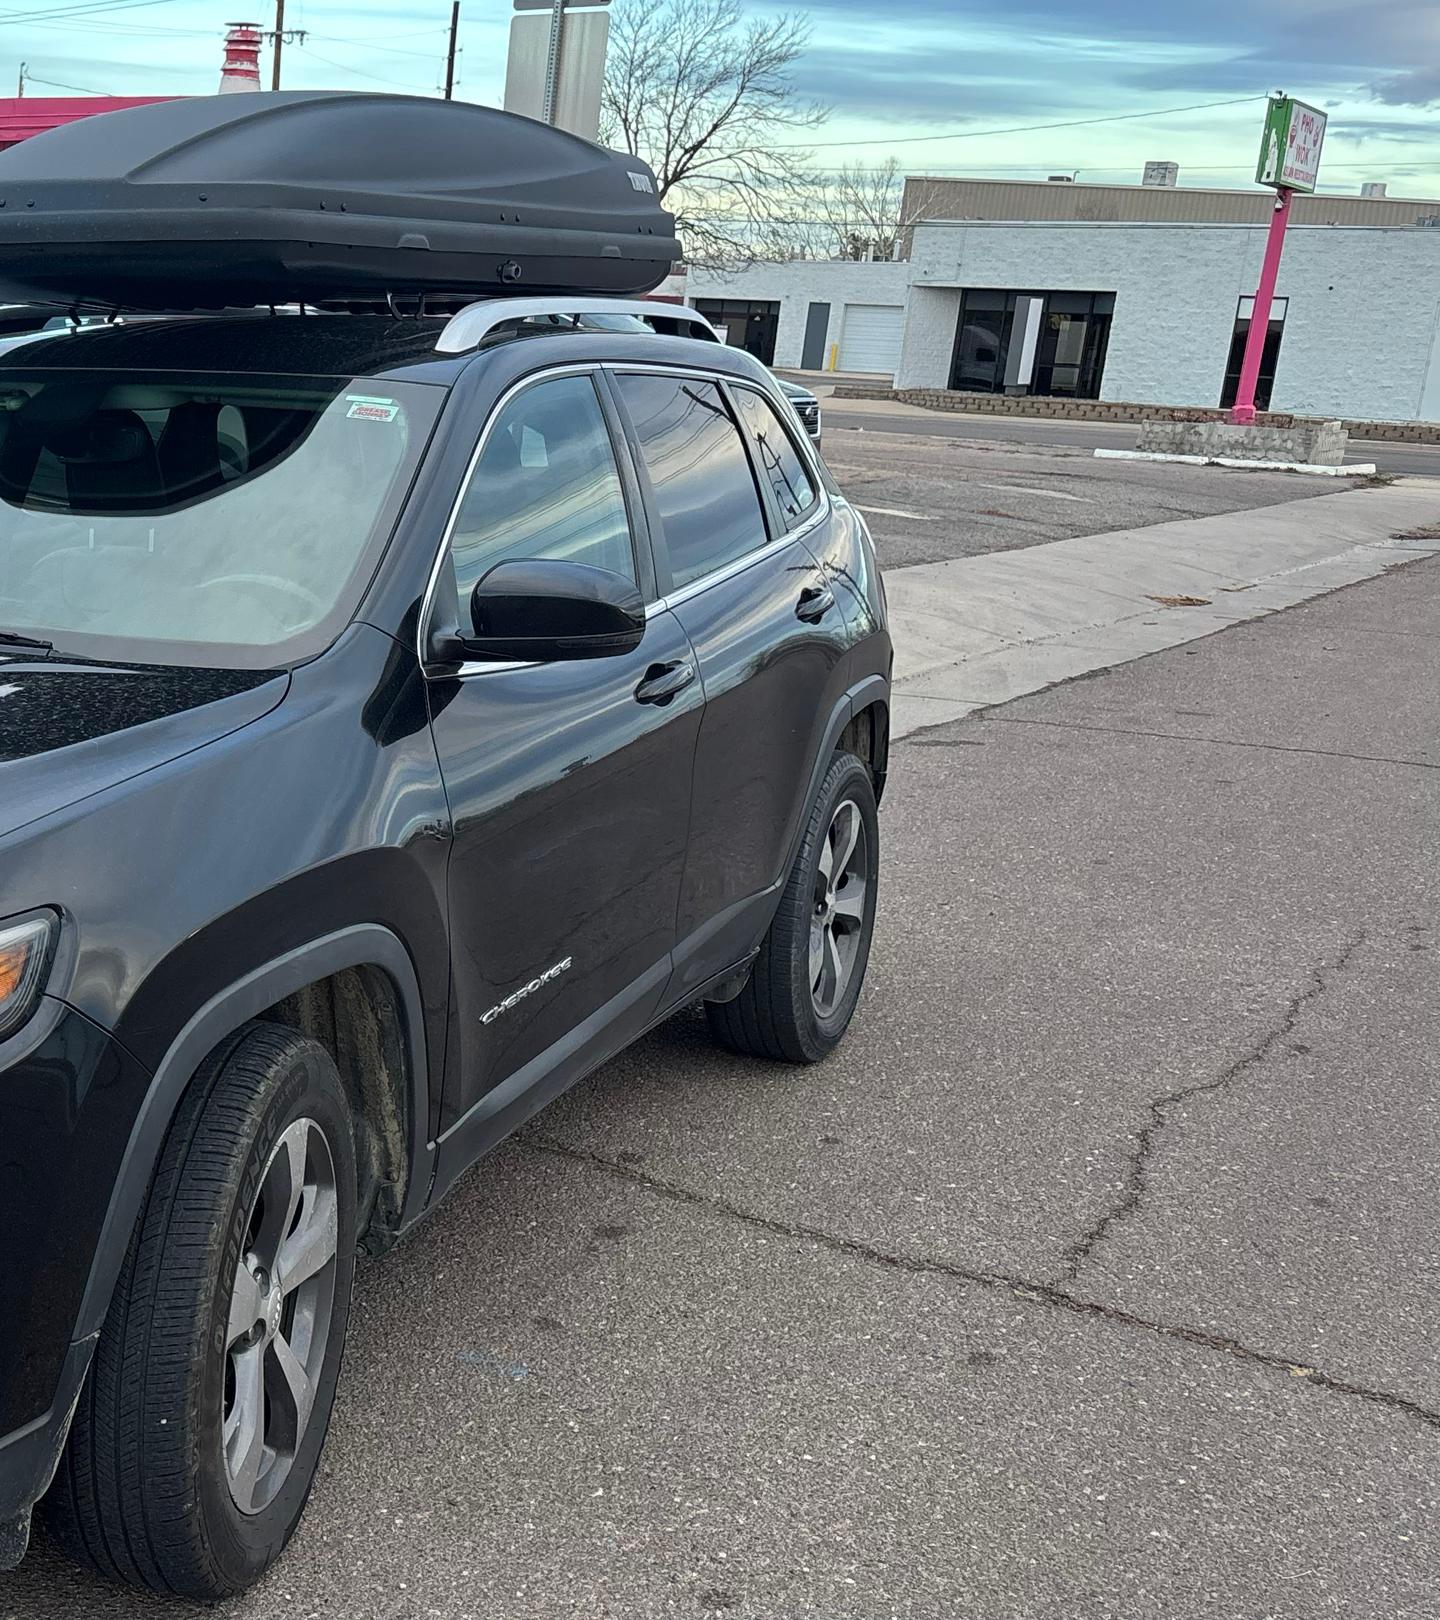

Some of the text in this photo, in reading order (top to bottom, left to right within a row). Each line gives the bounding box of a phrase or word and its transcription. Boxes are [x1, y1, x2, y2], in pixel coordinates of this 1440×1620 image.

[1301, 113, 1314, 136] PHO
[1295, 144, 1310, 167] WOK
[479, 957, 572, 1025] CHEROKEE
